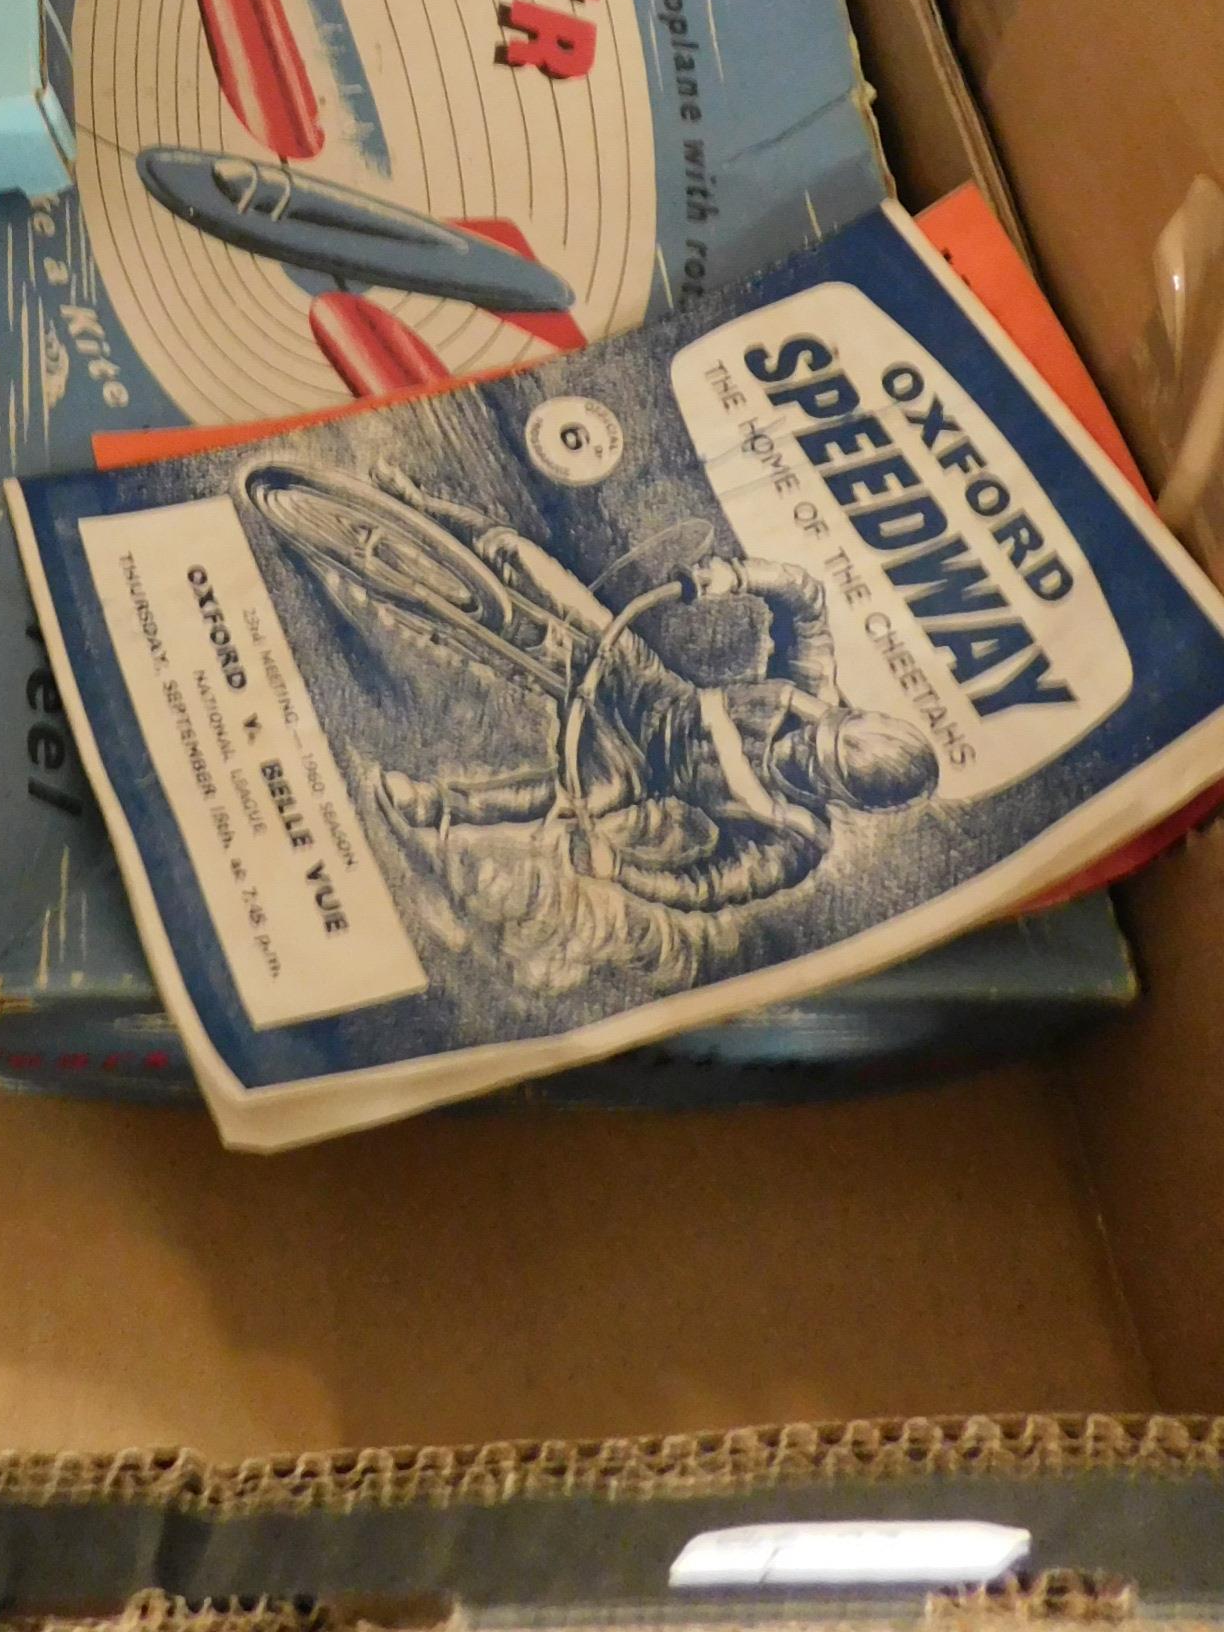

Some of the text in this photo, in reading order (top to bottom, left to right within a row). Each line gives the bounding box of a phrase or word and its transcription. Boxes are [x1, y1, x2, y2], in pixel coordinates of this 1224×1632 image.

[682, 138, 719, 225] with
[59, 305, 130, 410] Kite
[704, 359, 976, 769] THE HOME OF THE CHEETAHS
[743, 332, 1080, 718] SPEEDWAY
[881, 361, 1074, 602] OXFORD
[162, 679, 218, 802] SEPTEMBER
[186, 563, 247, 693] OXFORD
[259, 758, 315, 849] BELLE
[305, 859, 350, 935] VUE
[194, 669, 268, 838] NATIONAL LEAGUE
[260, 649, 300, 727] MEETING
